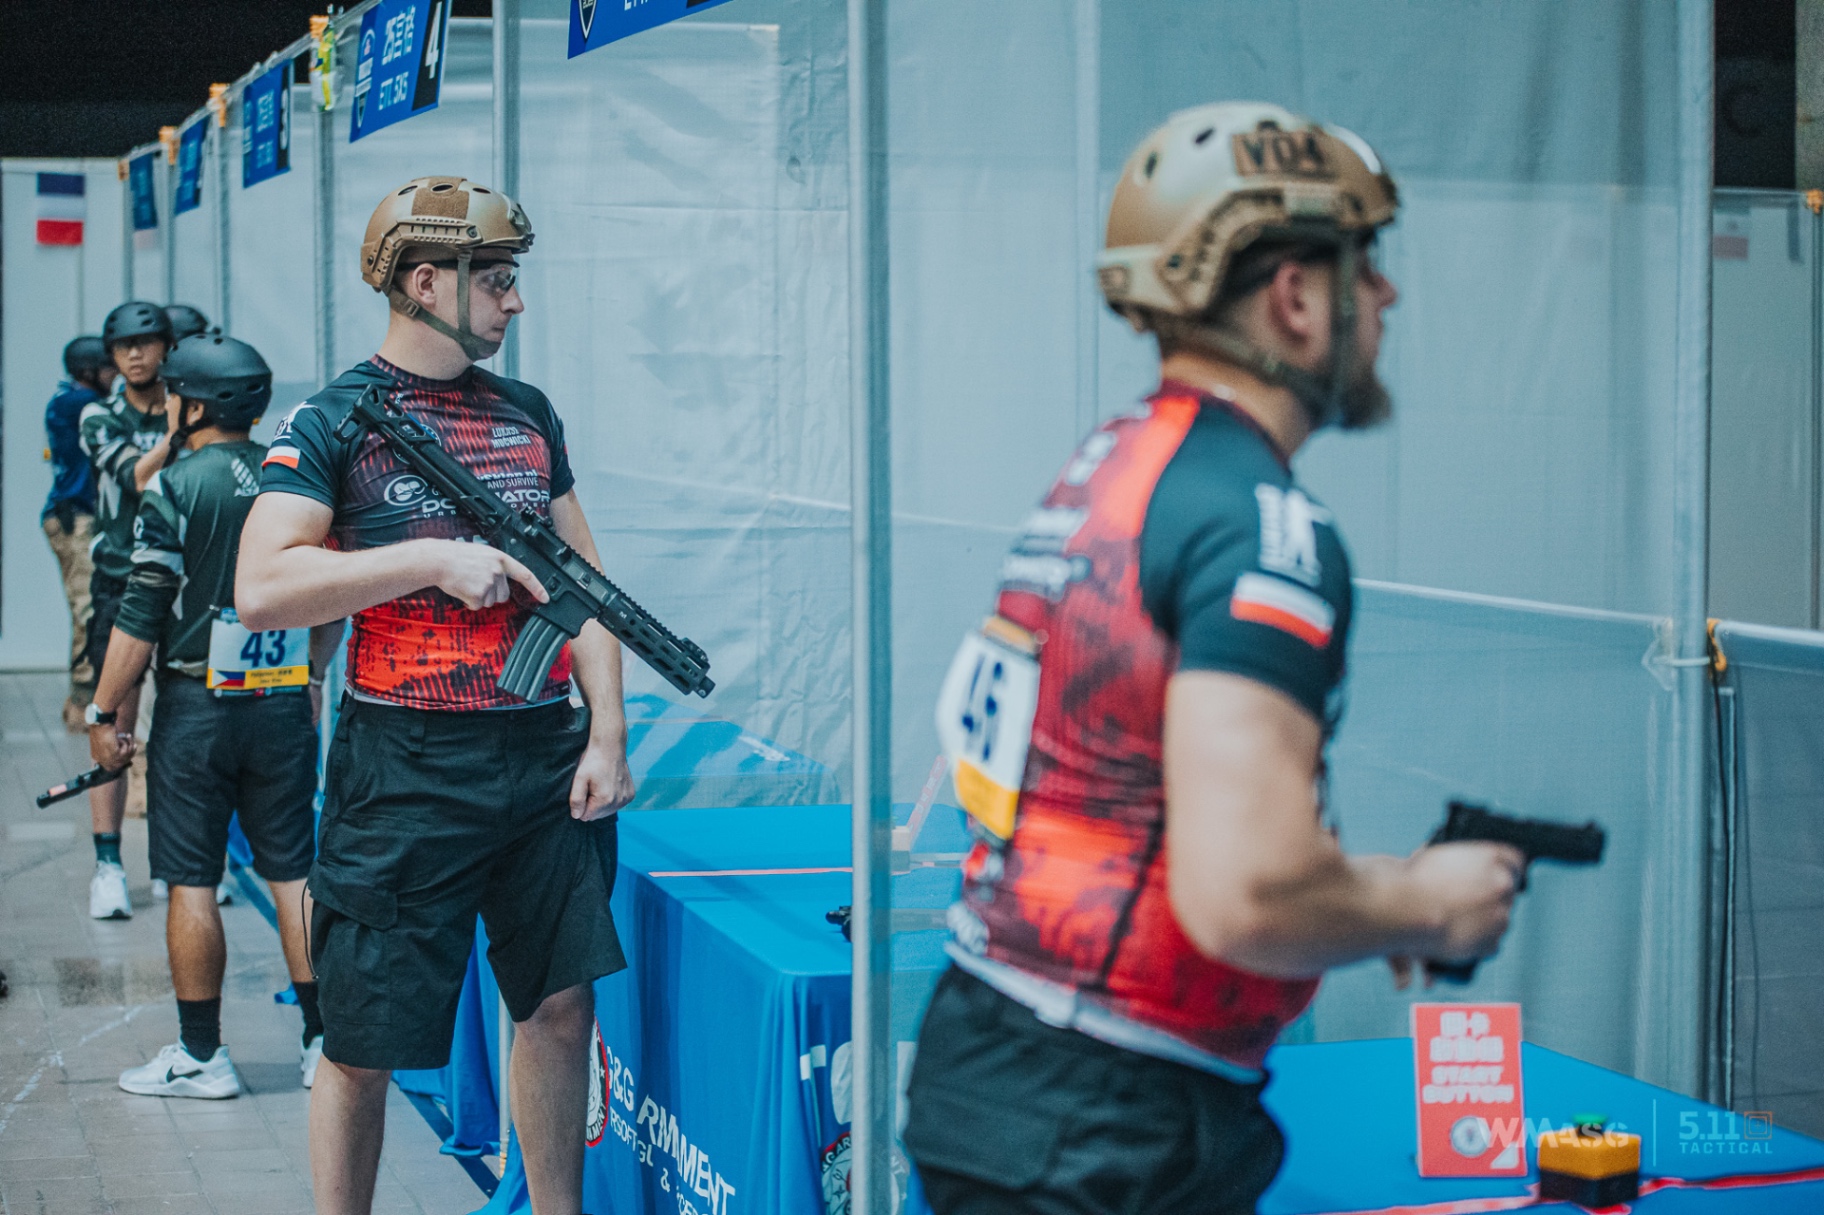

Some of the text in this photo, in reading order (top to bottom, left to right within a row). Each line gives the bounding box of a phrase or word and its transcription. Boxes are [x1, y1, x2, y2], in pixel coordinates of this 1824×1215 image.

[425, 1, 443, 79] 4
[487, 477, 539, 489] AND SURVIVE
[240, 630, 287, 668] 43
